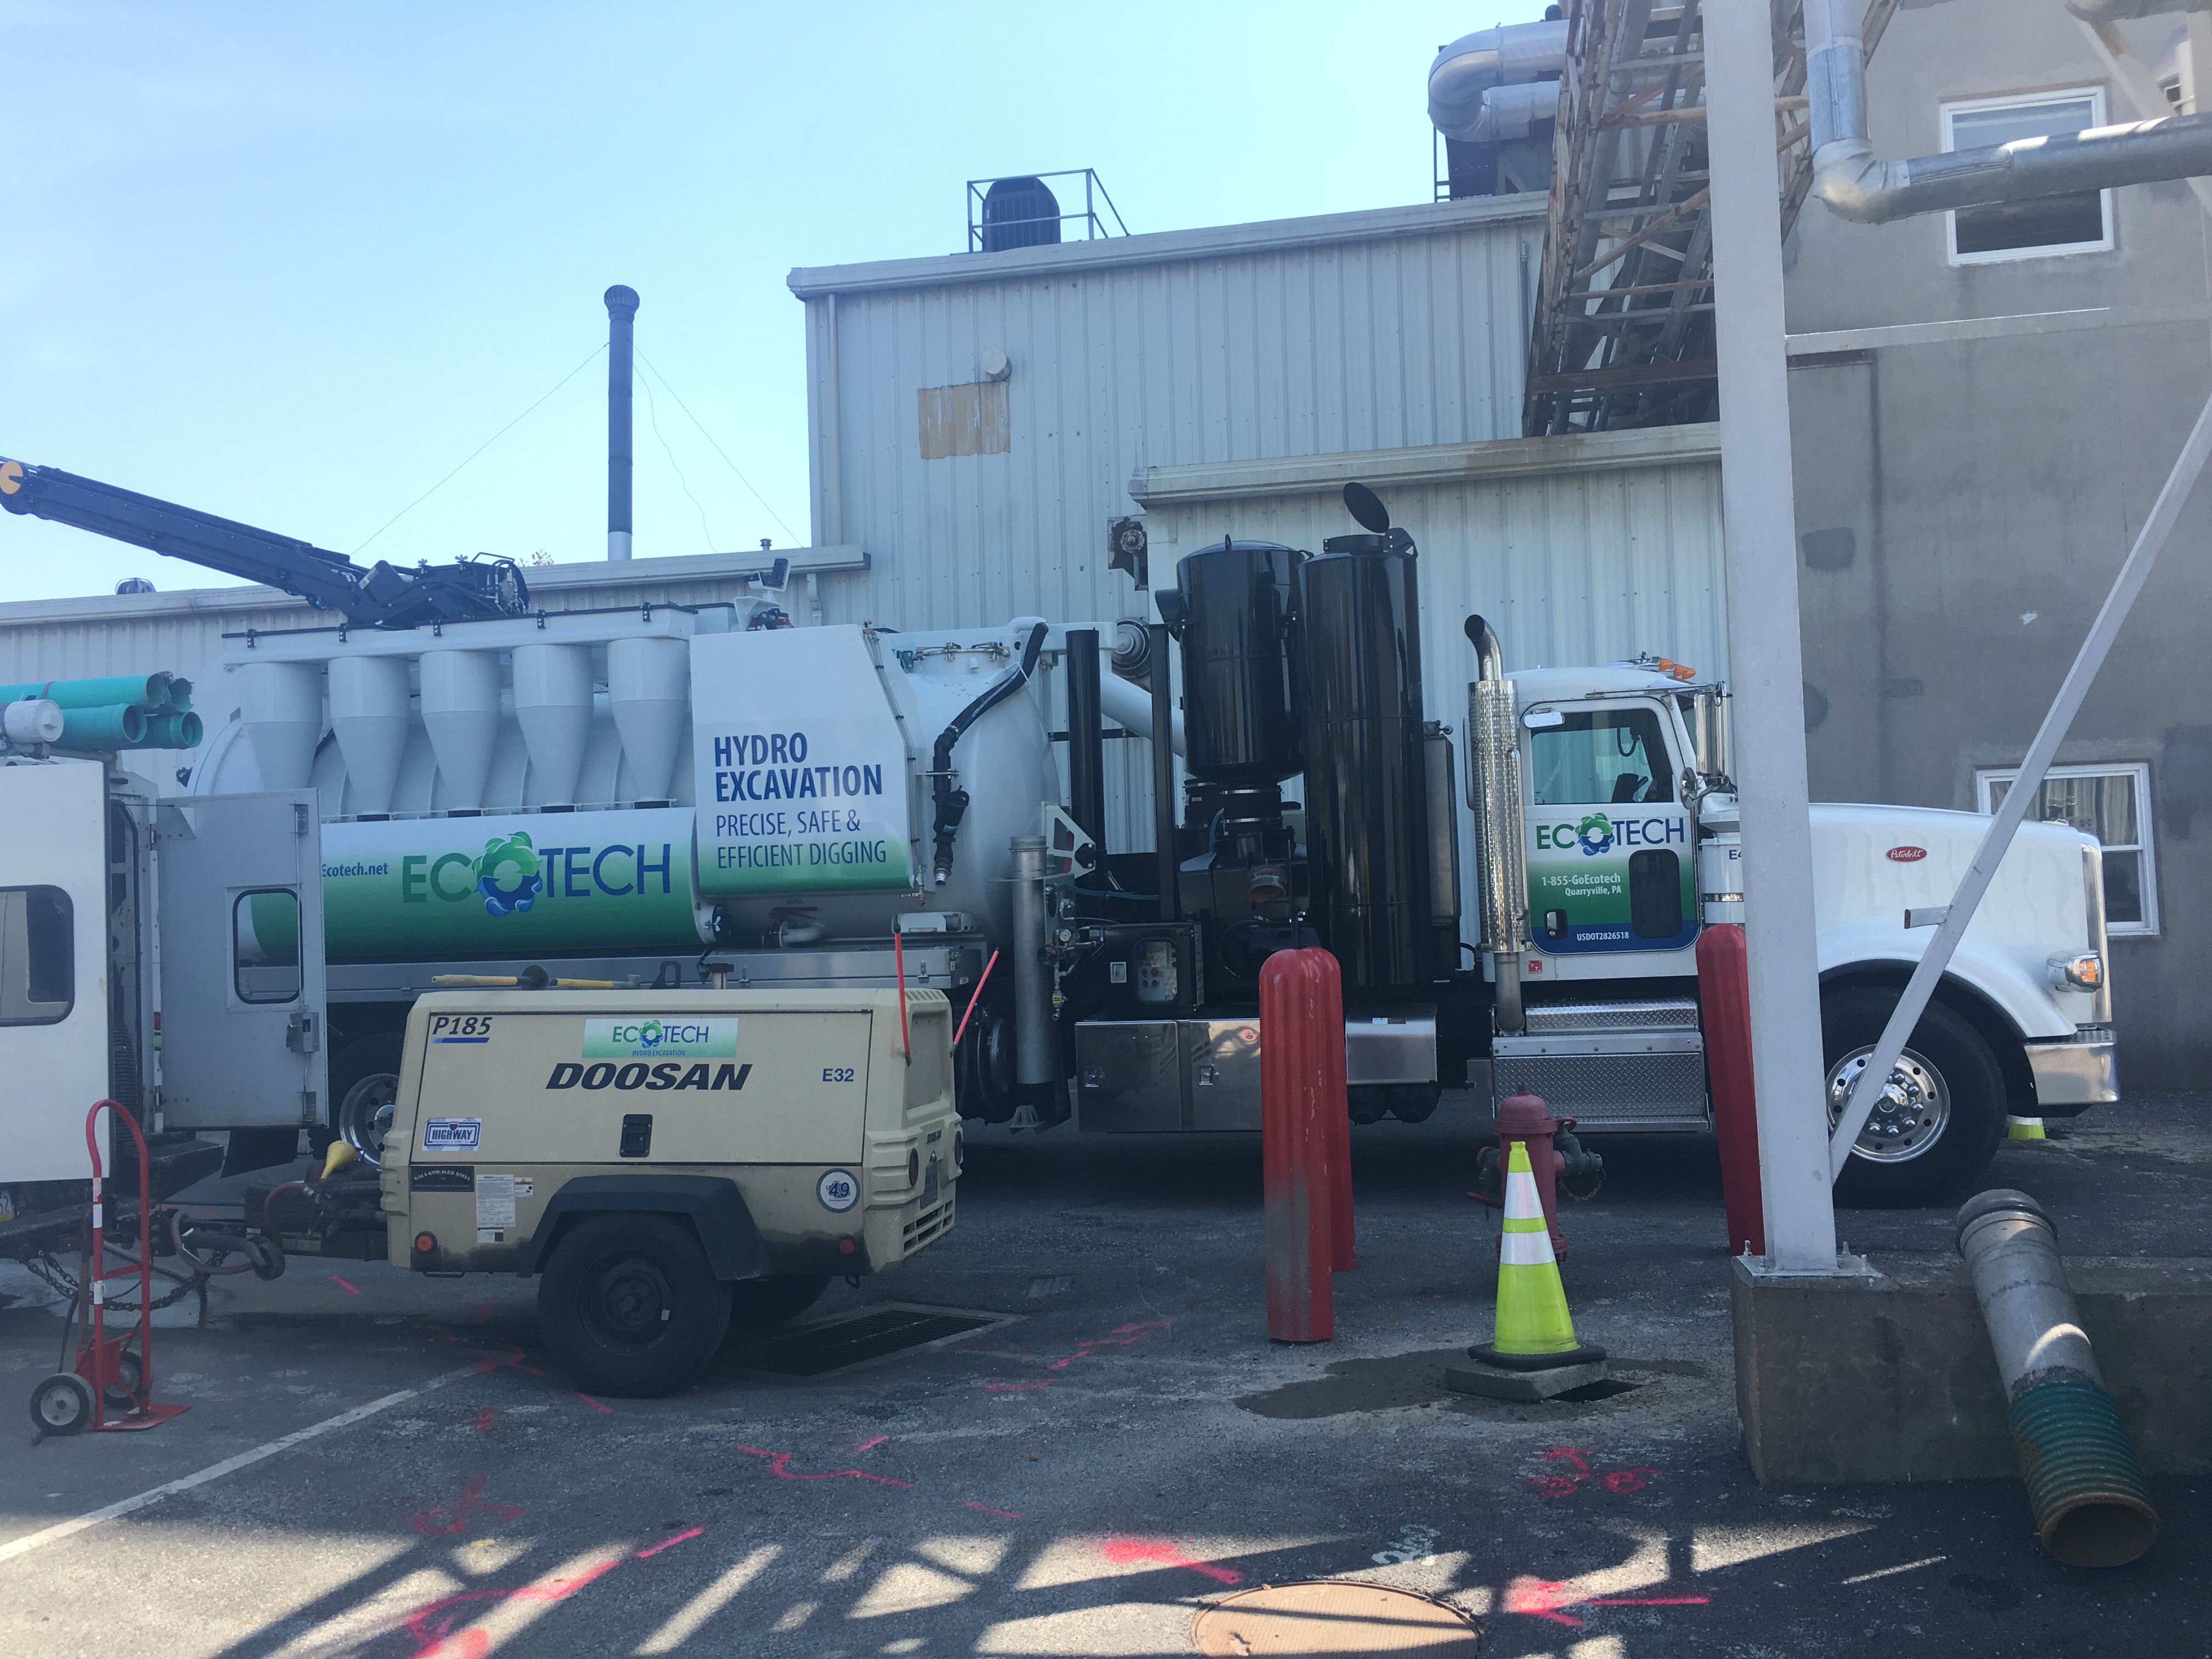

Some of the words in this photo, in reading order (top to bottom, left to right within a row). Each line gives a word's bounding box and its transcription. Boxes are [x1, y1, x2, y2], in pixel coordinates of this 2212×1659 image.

[714, 732, 808, 767] HYDRO
[716, 764, 883, 802] EXCAVATION
[717, 812, 792, 837] PRECISE,
[798, 810, 840, 834] SAFE
[847, 809, 861, 832] &
[1536, 812, 1685, 856] ECOTECH
[718, 844, 803, 869] EFFICIENT
[809, 840, 887, 865] DIGGING
[1891, 849, 1924, 859] Peterbilt
[403, 831, 670, 917] ECOTECH
[1541, 872, 1621, 887] 1-855-GoEcotech
[1565, 886, 1611, 896] Quarryville,
[1612, 885, 1622, 894] PA
[1576, 931, 1629, 941] USDOT2826518
[432, 1017, 493, 1036] P185
[612, 1019, 709, 1048] ECOTECH
[545, 1063, 753, 1091] DOOSAN
[822, 1068, 854, 1082] E32
[432, 1129, 473, 1140] HIGHWAY
[828, 1182, 850, 1197] 49
